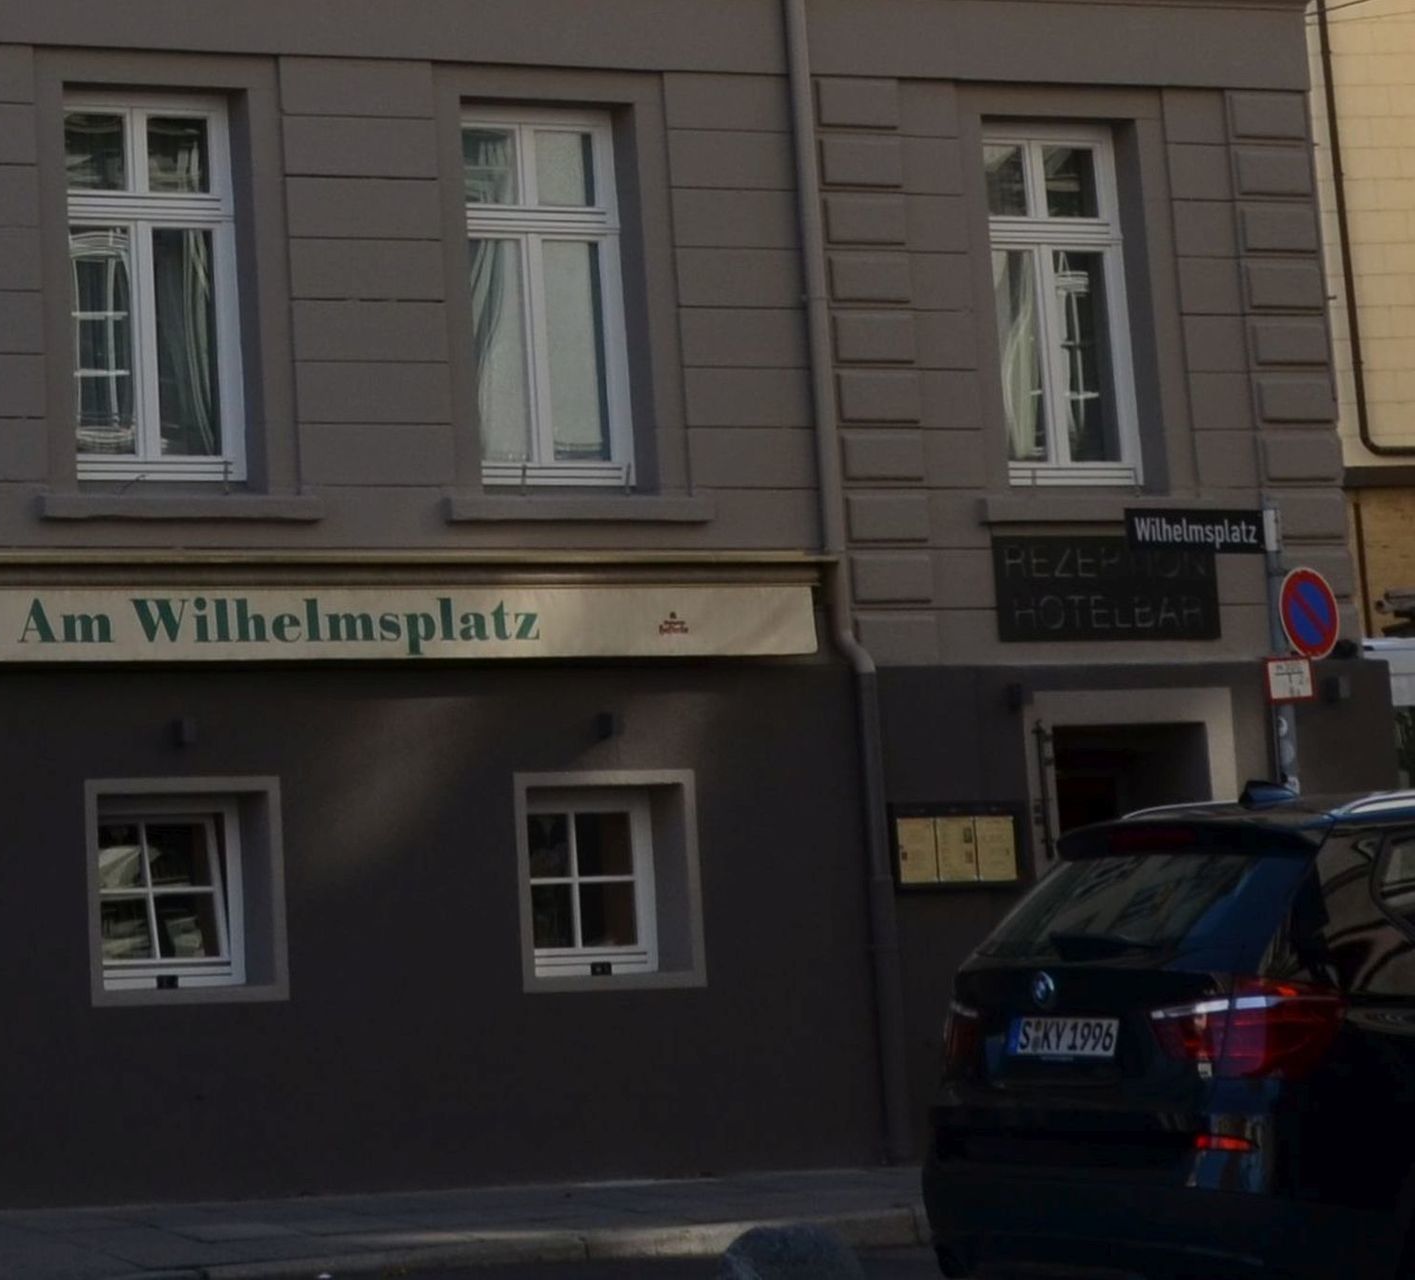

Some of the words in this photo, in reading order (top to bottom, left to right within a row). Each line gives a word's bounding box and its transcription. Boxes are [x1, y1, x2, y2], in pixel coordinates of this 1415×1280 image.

[1134, 517, 1258, 550] Wilhelmsplatz
[18, 597, 114, 644] Am
[128, 597, 540, 655] Wilhelmsplatz
[1013, 596, 1204, 629] HOTELBAR
[1067, 1021, 1114, 1051] 1996
